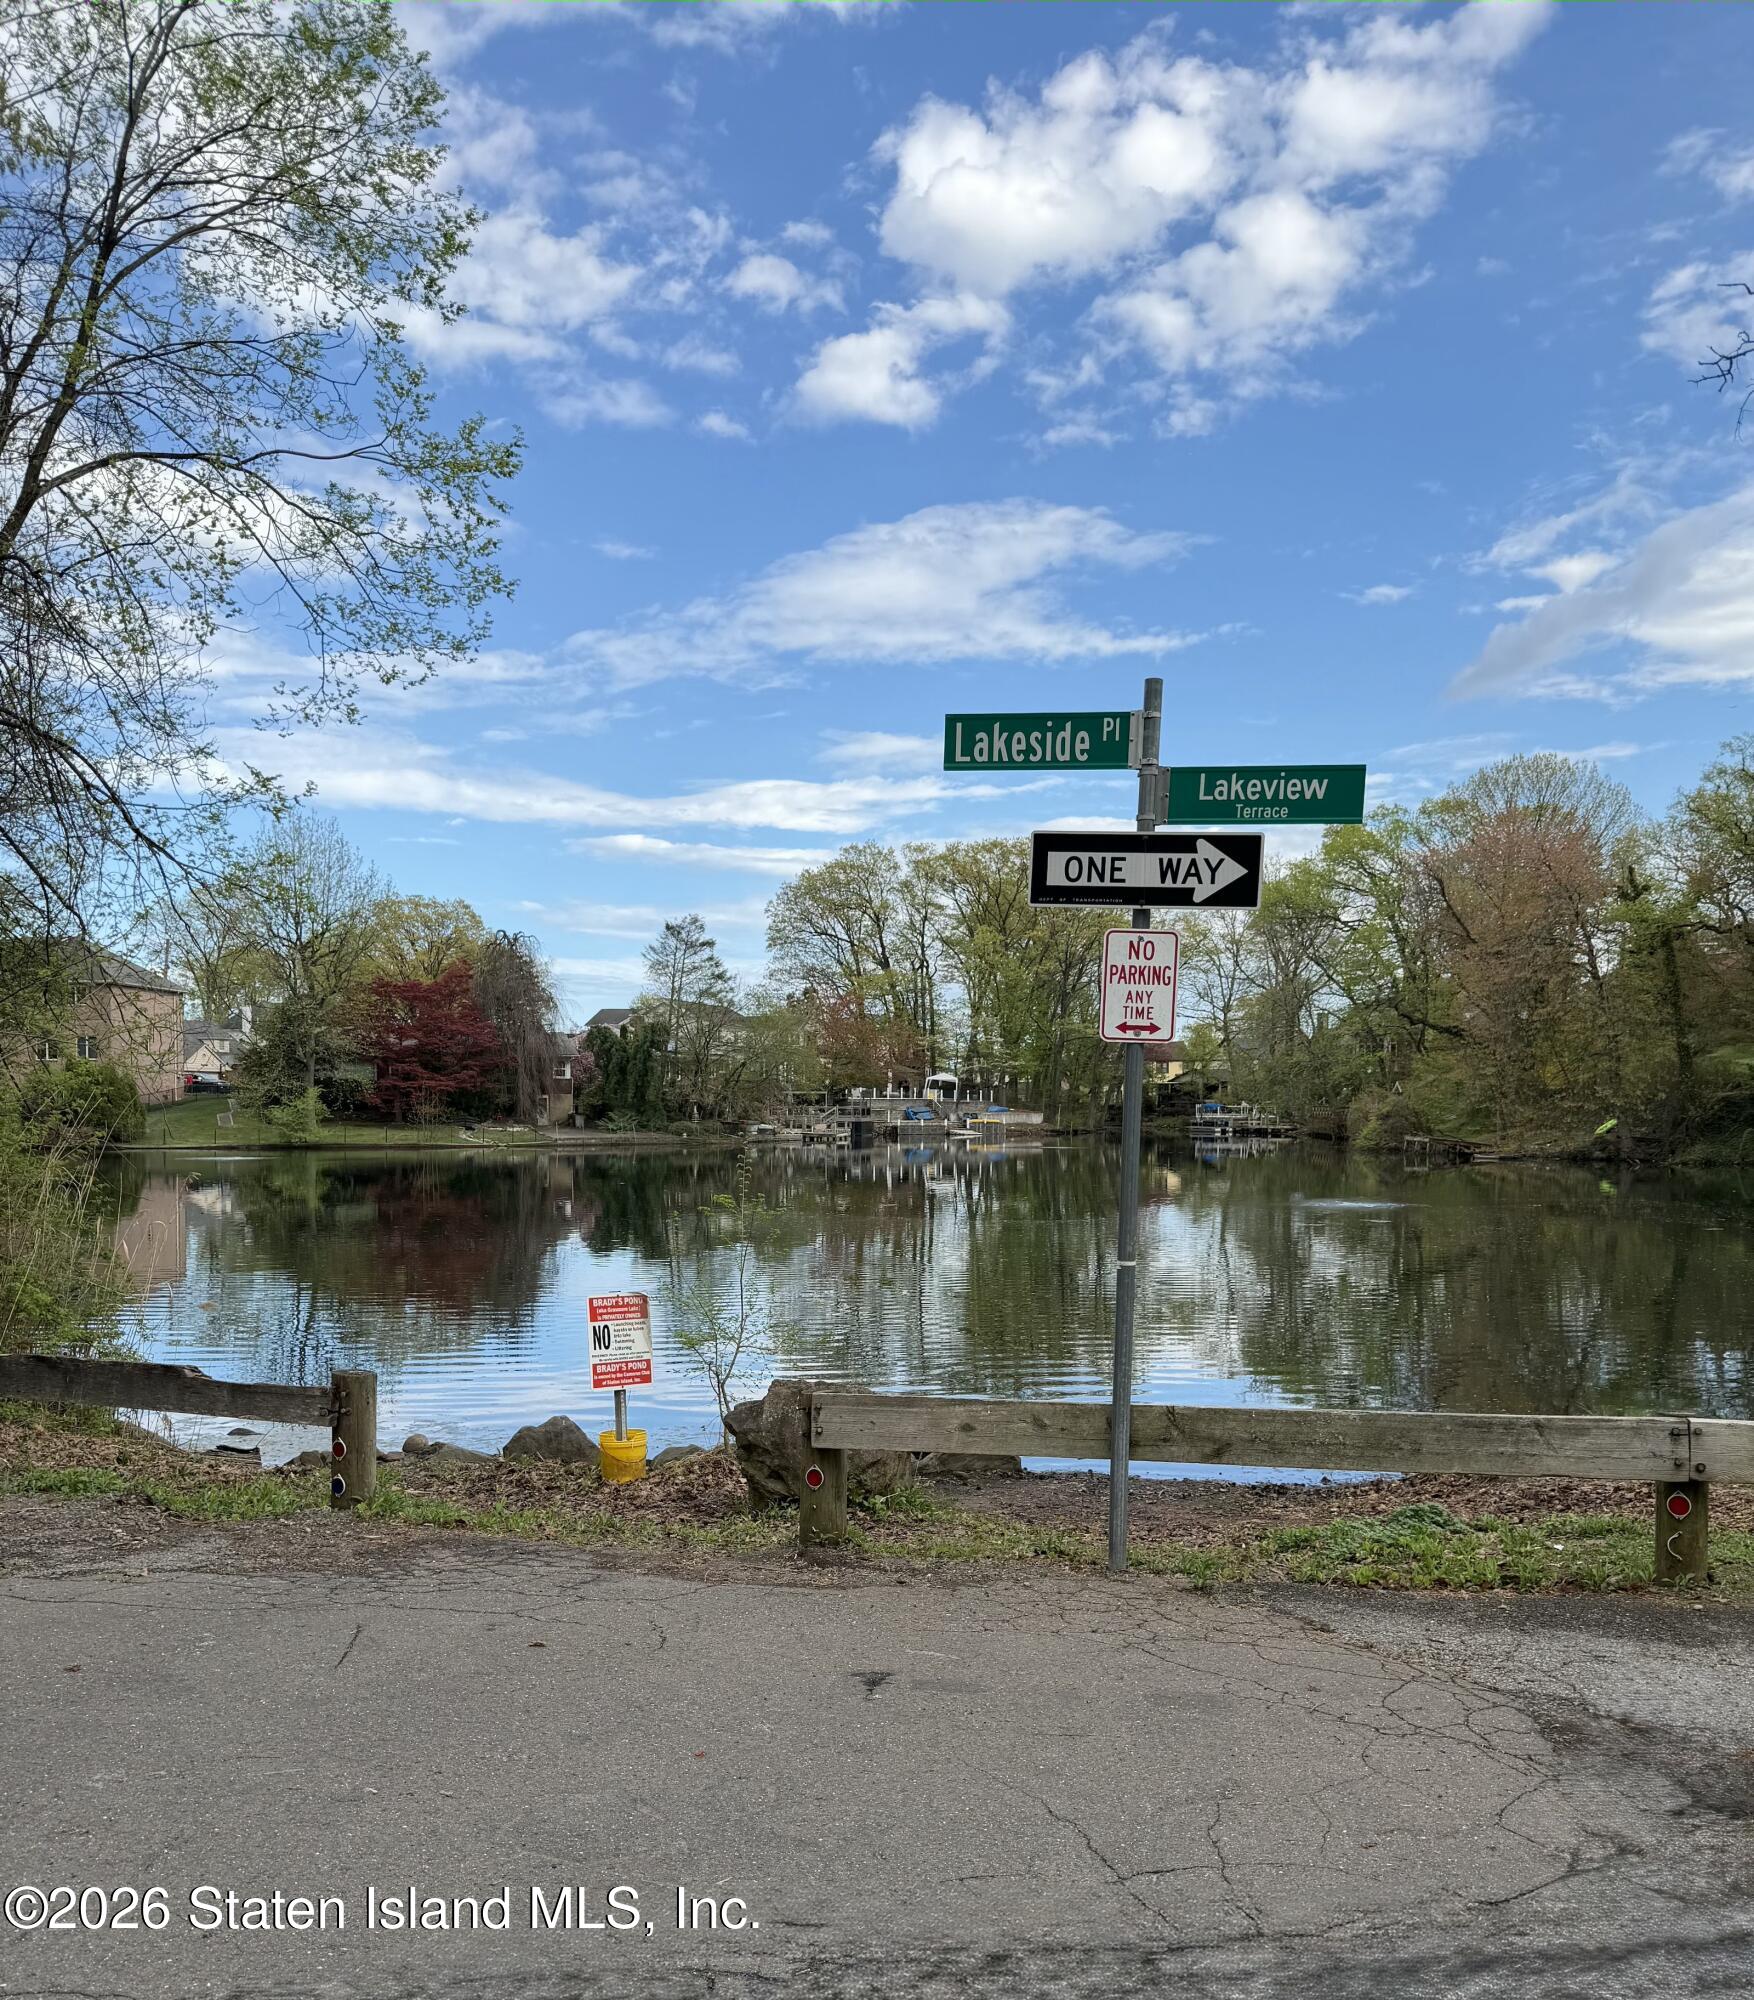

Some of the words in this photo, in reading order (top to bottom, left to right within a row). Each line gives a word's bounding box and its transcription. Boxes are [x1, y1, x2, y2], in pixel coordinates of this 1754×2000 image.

[955, 720, 1090, 763] Lakeside
[1102, 717, 1120, 742] Pl
[1198, 772, 1329, 801] Lakeview
[1235, 803, 1289, 819] Terrace
[1064, 855, 1127, 884] ONE
[1158, 857, 1225, 885] WAY
[1128, 940, 1155, 961] NO
[1109, 964, 1172, 987] PARKING
[1125, 990, 1153, 1004] ANY
[1122, 1005, 1154, 1020] TIME
[594, 1298, 623, 1307] BRADY'S
[625, 1297, 643, 1305] POND
[593, 1325, 611, 1351] NO
[597, 1364, 627, 1373] BRADY'S
[629, 1362, 647, 1370] POND
